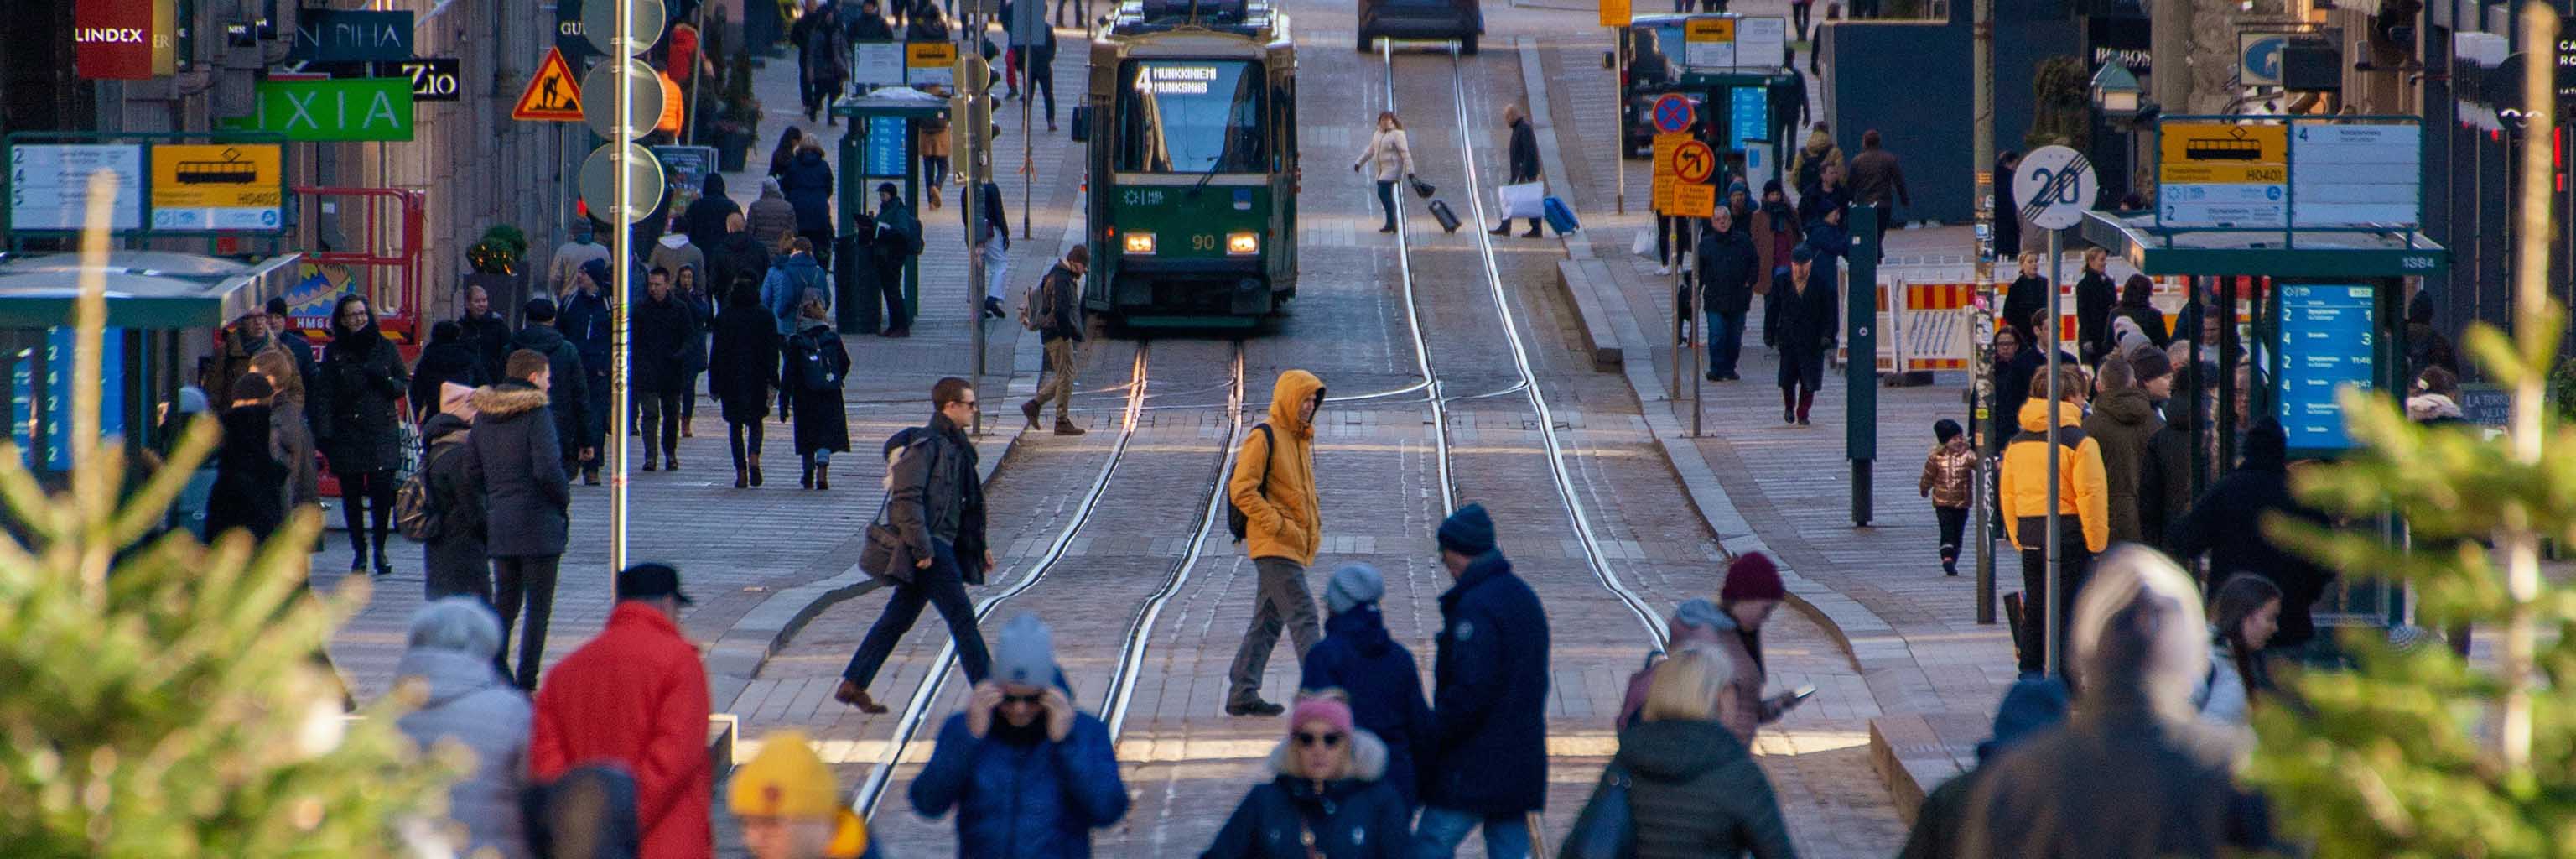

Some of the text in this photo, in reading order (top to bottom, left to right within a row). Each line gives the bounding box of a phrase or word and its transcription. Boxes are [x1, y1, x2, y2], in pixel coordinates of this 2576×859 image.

[75, 28, 143, 43] LINDEX
[560, 21, 587, 35] GU
[402, 63, 456, 95] Zio
[1135, 65, 1217, 94] 4 MUNKKINIEMI
[2298, 127, 2308, 142] 4
[13, 147, 24, 164] 2
[13, 167, 25, 182] 4
[2031, 167, 2080, 206] 20
[2166, 206, 2175, 221] 2
[1192, 234, 1215, 251] 90
[2283, 308, 2292, 322] 2
[2365, 310, 2372, 322] 1
[2283, 331, 2292, 345] 4
[2361, 332, 2372, 346] 3
[48, 345, 58, 361] 2
[2283, 354, 2292, 369] 2
[47, 371, 58, 385] 4
[2282, 379, 2291, 393] 4
[48, 396, 58, 411] 2
[2283, 402, 2291, 416] 2
[47, 421, 58, 435] 4
[48, 446, 58, 461] 2
